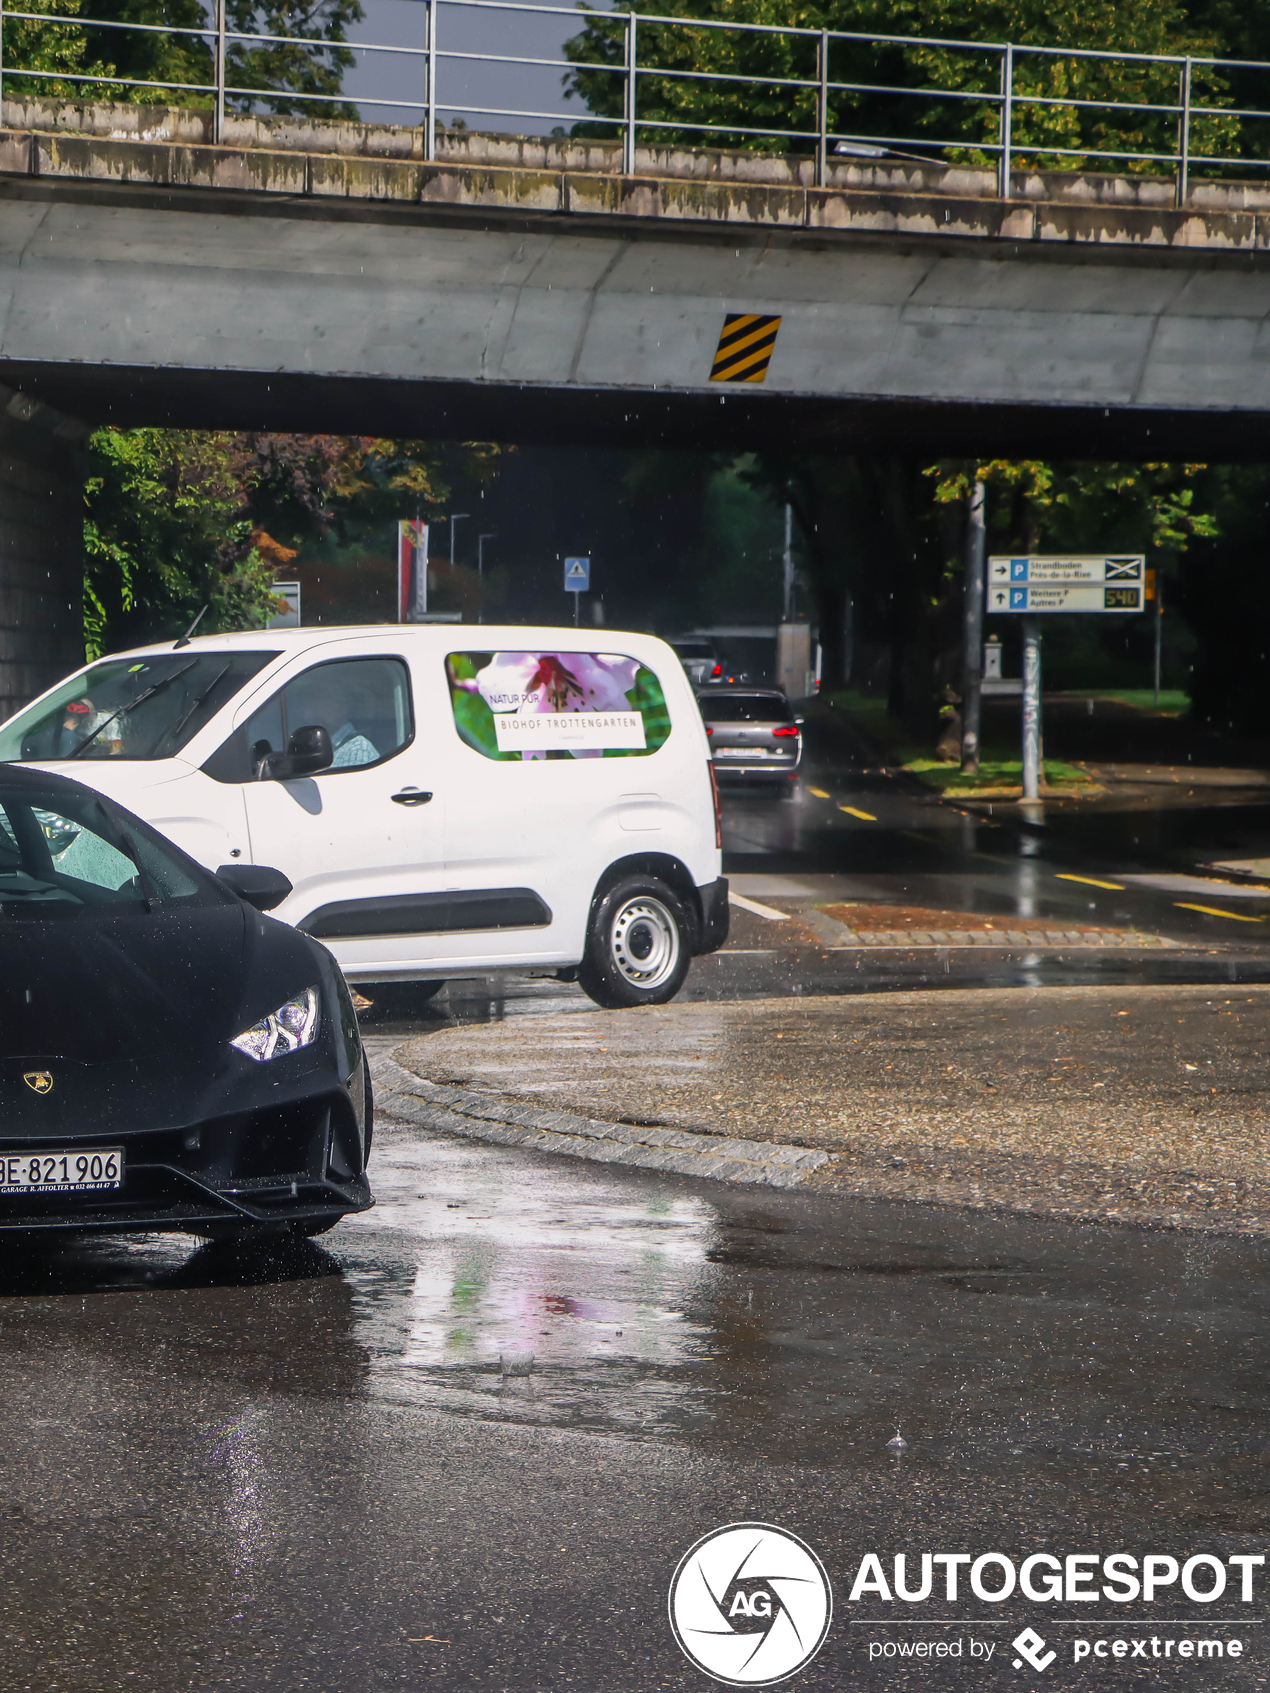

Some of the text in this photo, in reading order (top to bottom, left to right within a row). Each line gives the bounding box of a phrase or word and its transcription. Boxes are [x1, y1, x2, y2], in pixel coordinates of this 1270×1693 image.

[1030, 561, 1082, 569] Strandboden
[1106, 590, 1137, 605] 540
[490, 693, 540, 704] NATUR PUR
[501, 718, 637, 730] BIOHOF TROTTENGARTEN
[37, 1184, 70, 1192] AFFOLTER
